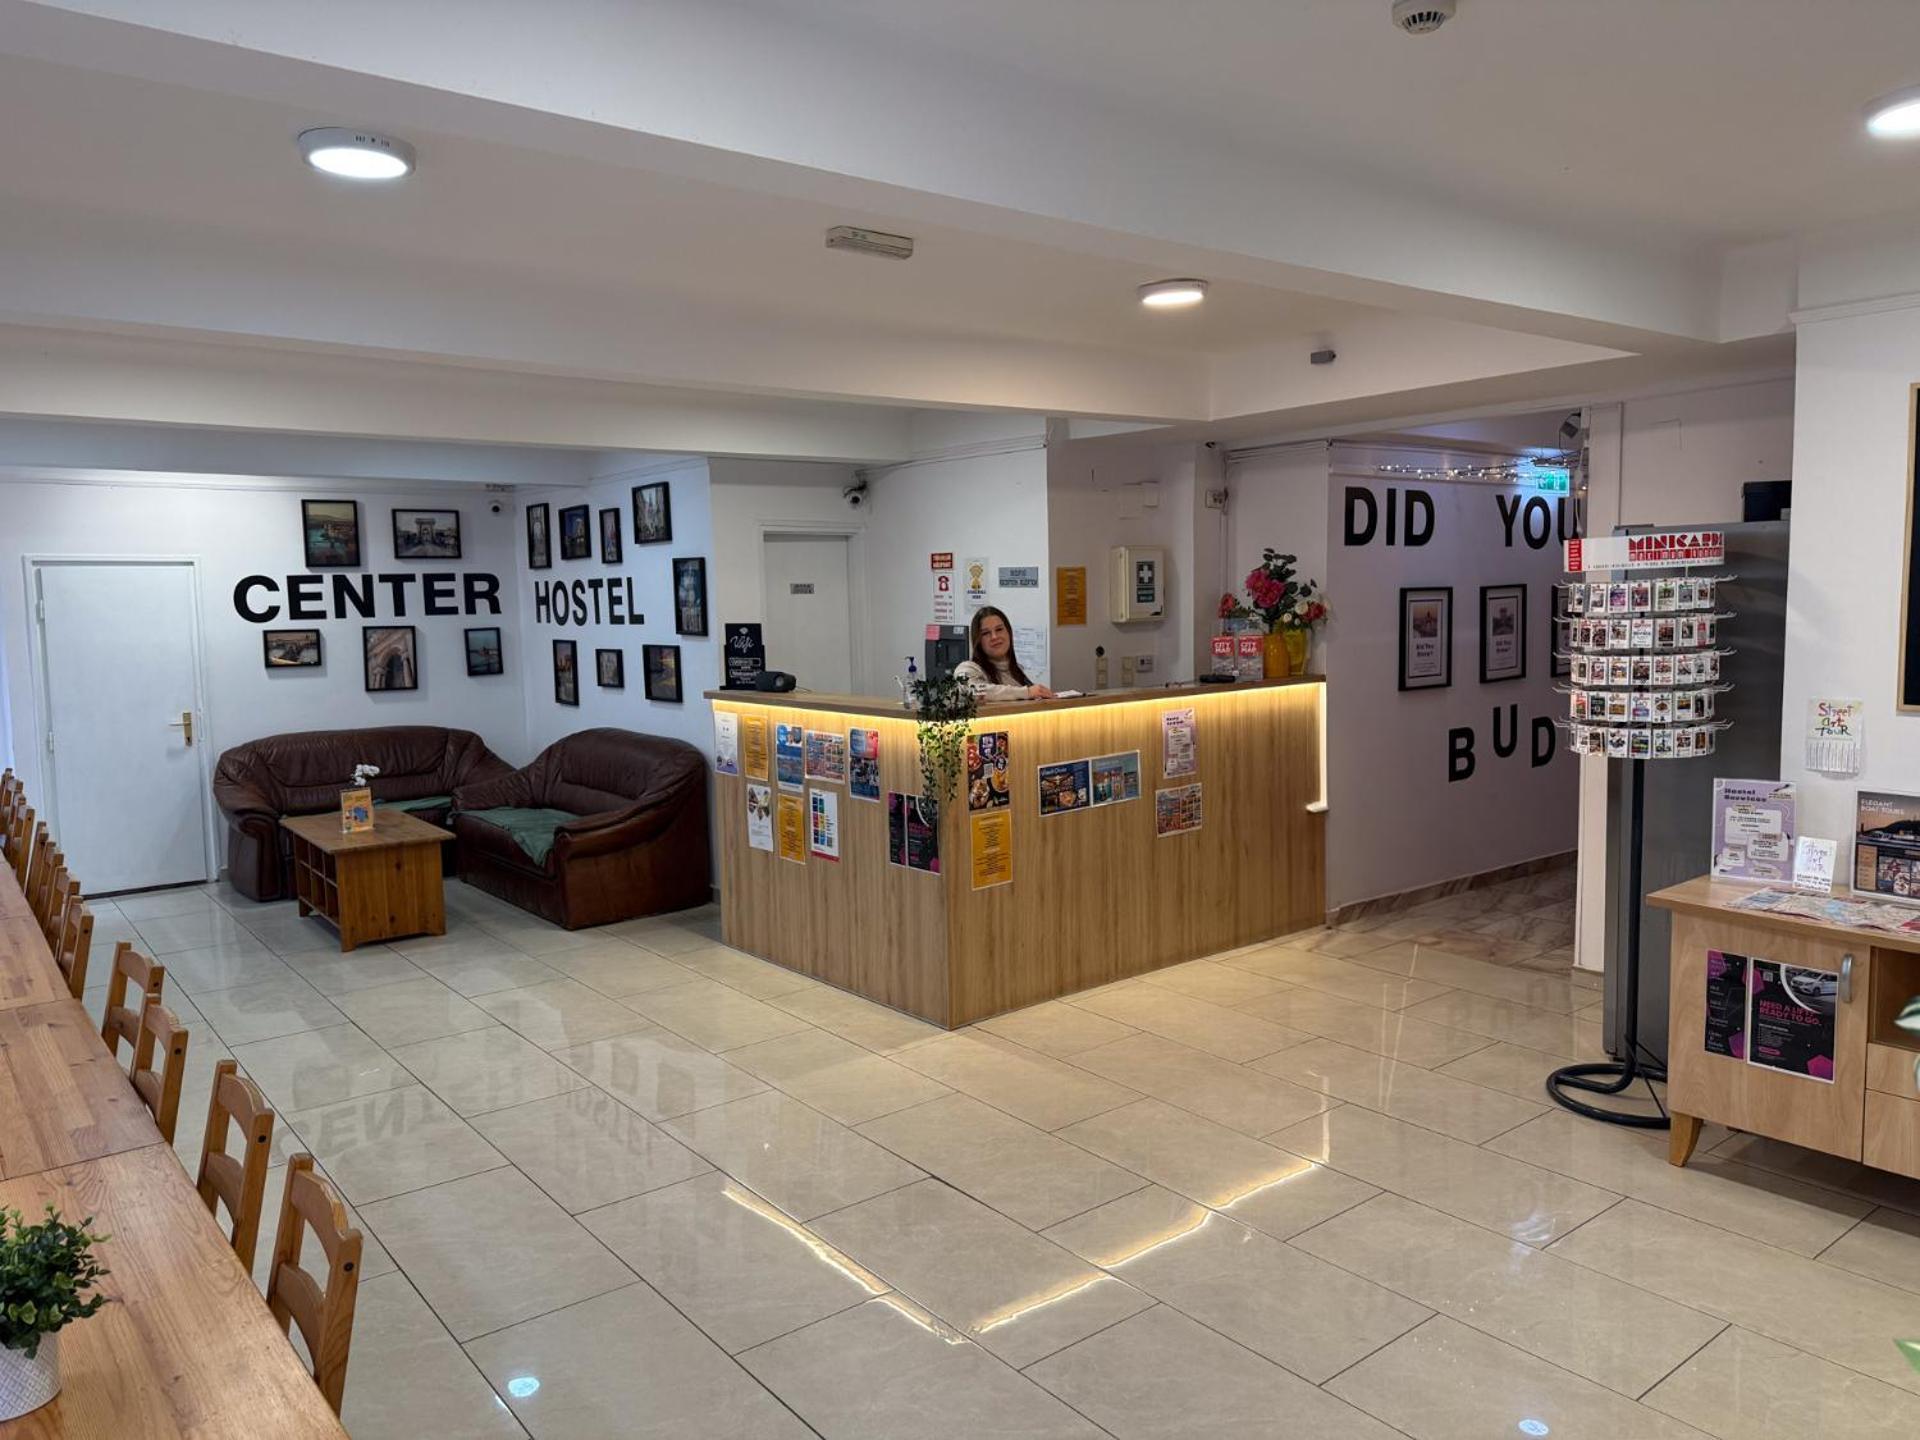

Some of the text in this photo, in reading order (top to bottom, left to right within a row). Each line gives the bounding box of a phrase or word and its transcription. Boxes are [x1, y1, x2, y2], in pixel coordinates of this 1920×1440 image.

[1344, 486, 1584, 549] DID YOU
[233, 573, 501, 623] CENTER
[534, 576, 644, 626] HOSTEL
